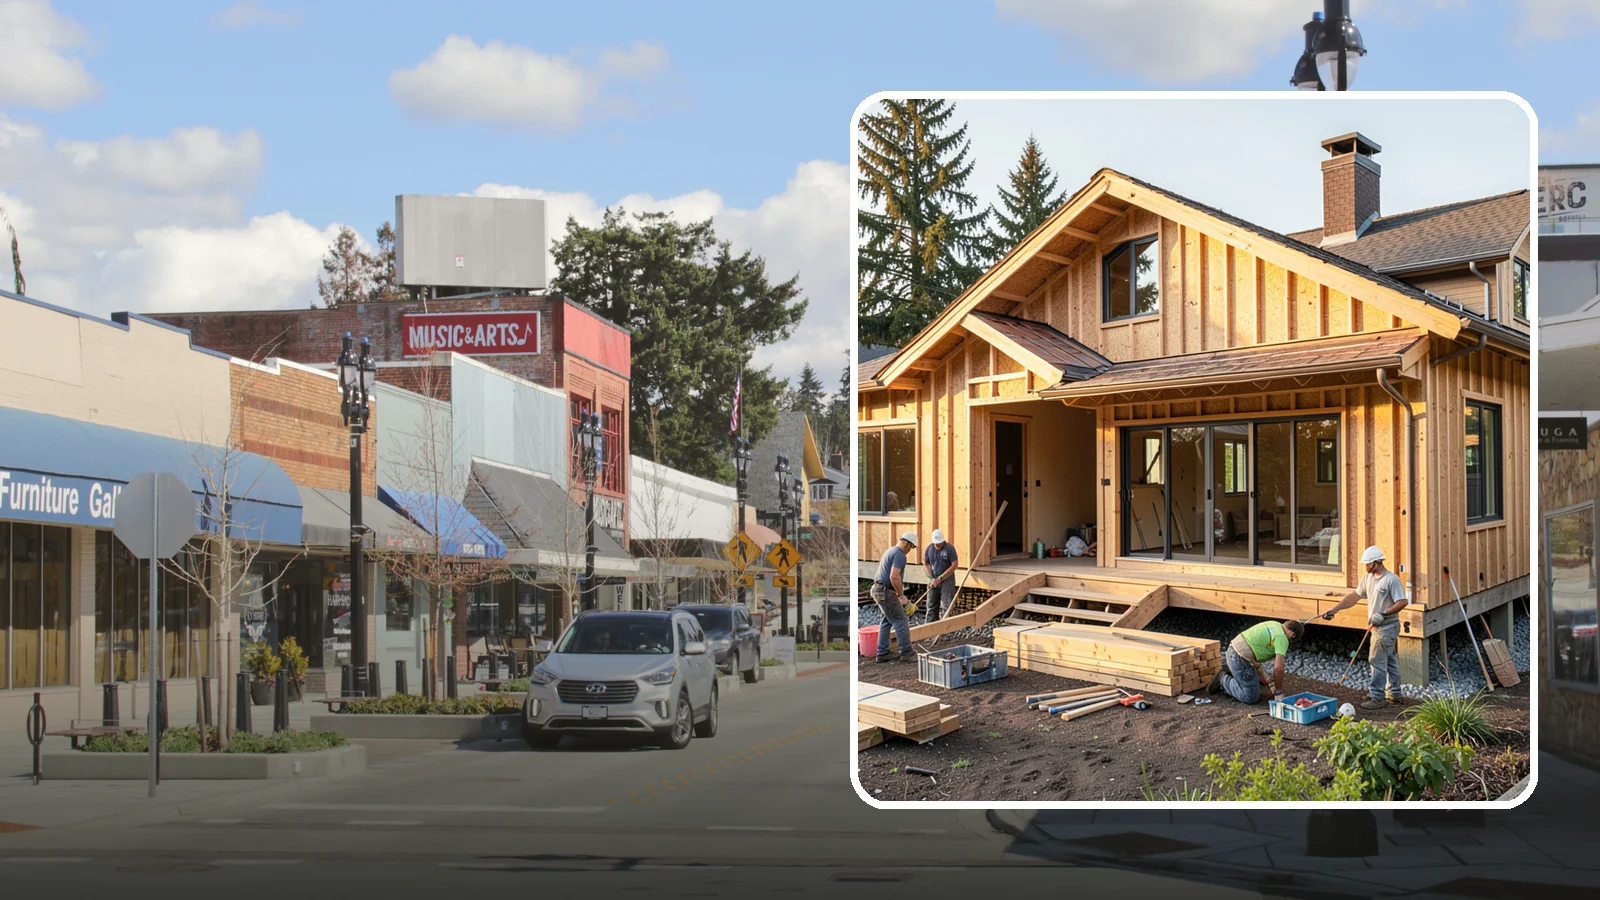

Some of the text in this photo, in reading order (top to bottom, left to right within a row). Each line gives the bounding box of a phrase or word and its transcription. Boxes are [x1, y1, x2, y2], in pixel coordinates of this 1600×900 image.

[0, 471, 121, 519] Furniture Gal
[453, 563, 480, 574] SUSHI
